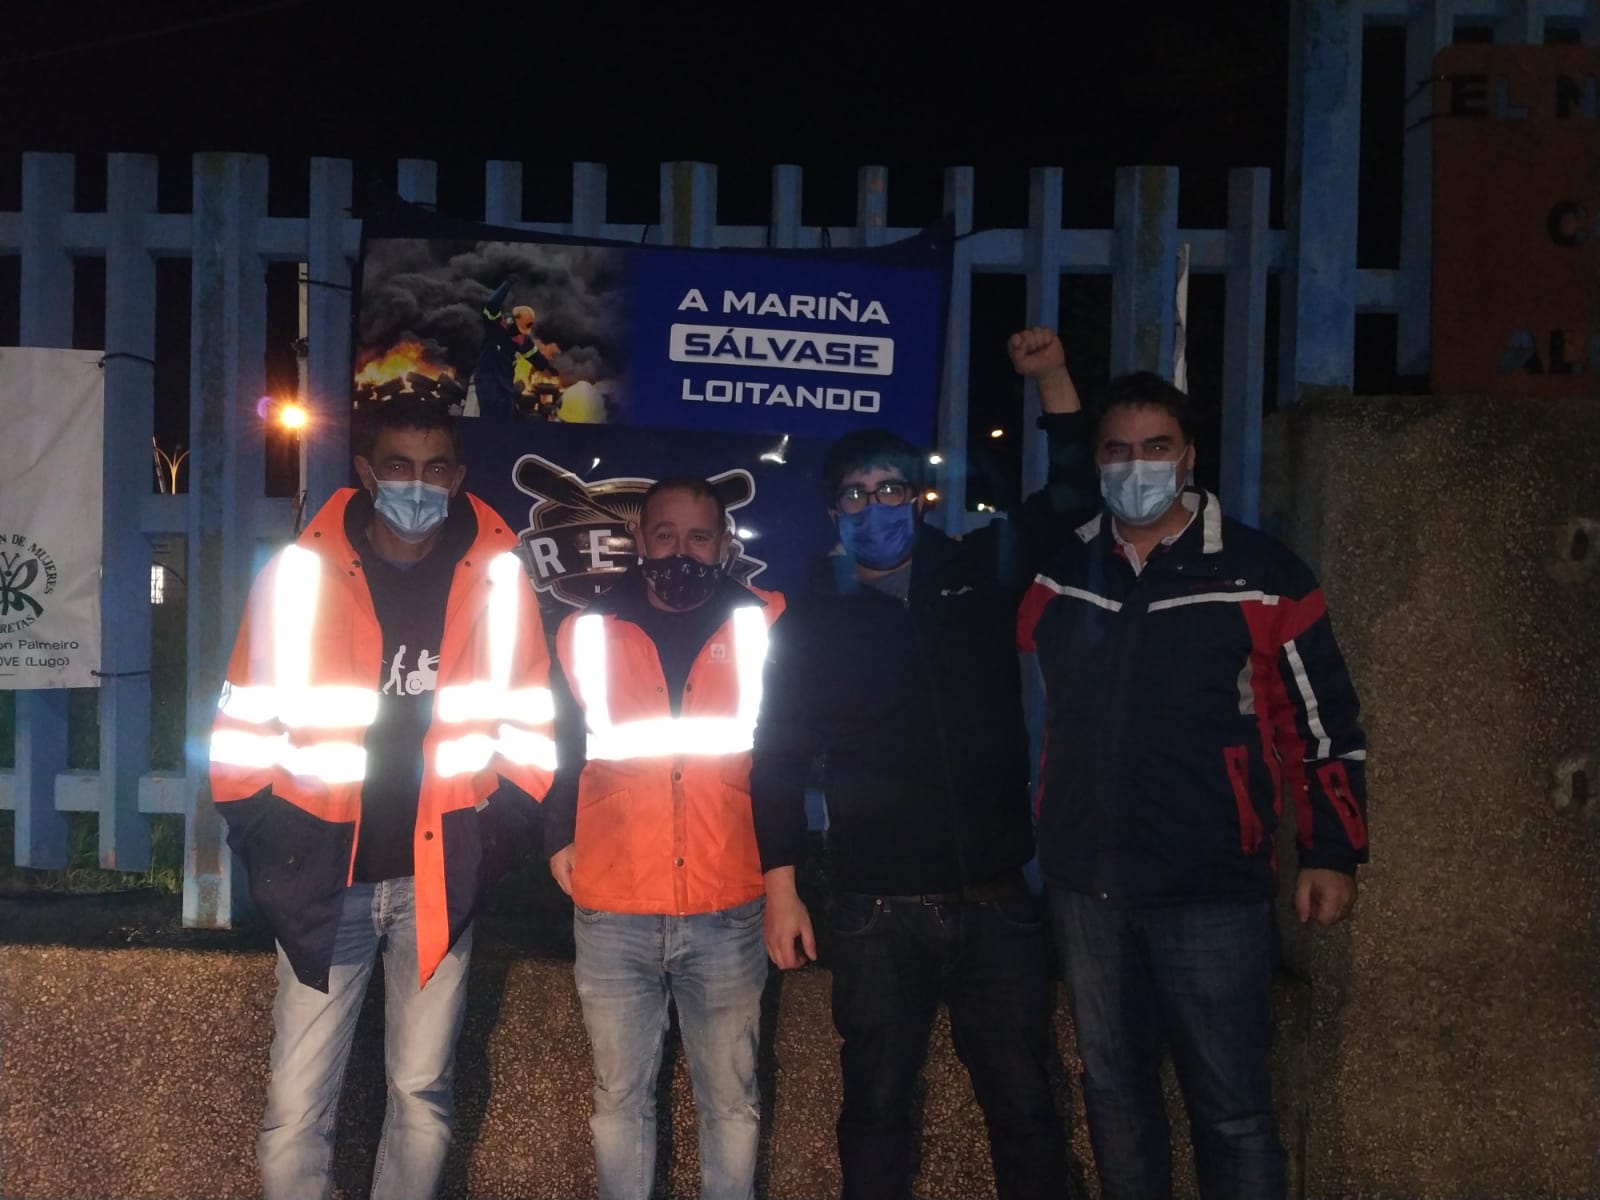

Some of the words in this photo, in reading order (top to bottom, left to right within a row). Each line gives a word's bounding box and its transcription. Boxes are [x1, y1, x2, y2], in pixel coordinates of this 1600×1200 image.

[1450, 74, 1529, 120] EL
[1547, 201, 1600, 247] C
[677, 288, 709, 312] A
[722, 290, 890, 325] MARIÑA
[684, 328, 879, 368] SÁLVASE
[681, 378, 881, 413] LOITANDO
[12, 534, 26, 547] DE
[27, 543, 57, 594] MUJERES
[18, 639, 79, 650] Palmeiro
[25, 656, 70, 669] (Lugo)
